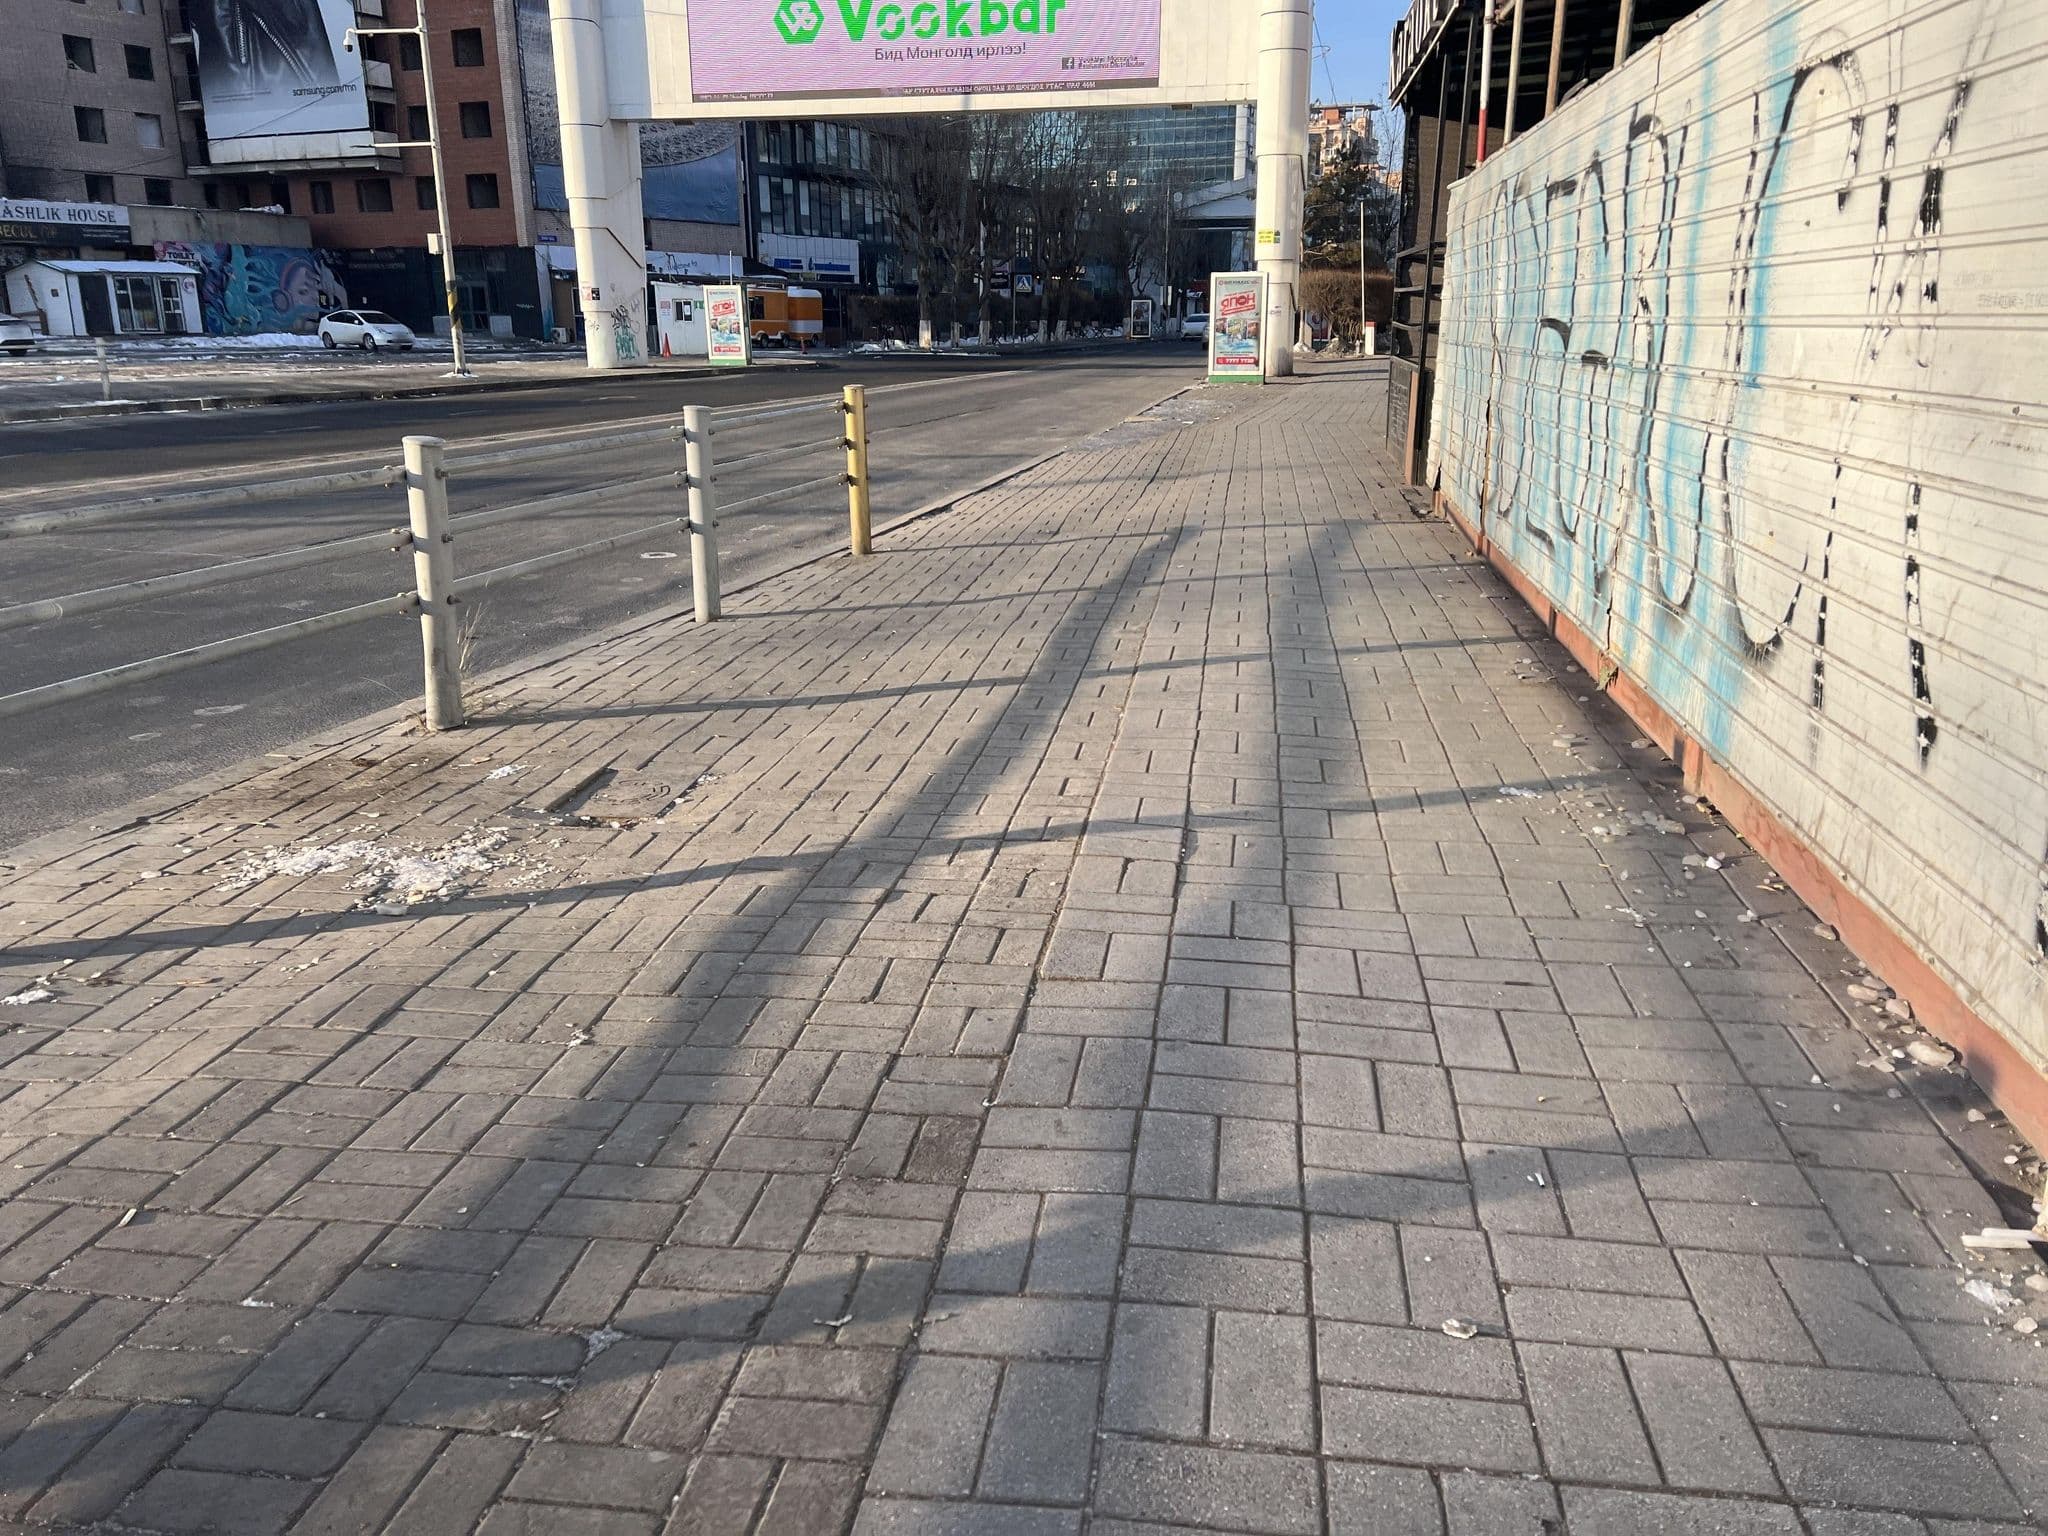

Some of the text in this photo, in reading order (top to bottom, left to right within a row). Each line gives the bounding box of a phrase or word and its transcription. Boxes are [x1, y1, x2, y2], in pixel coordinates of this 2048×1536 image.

[874, 42, 1026, 62] Бид Монголд ирлээ!
[67, 208, 116, 223] HOUSE
